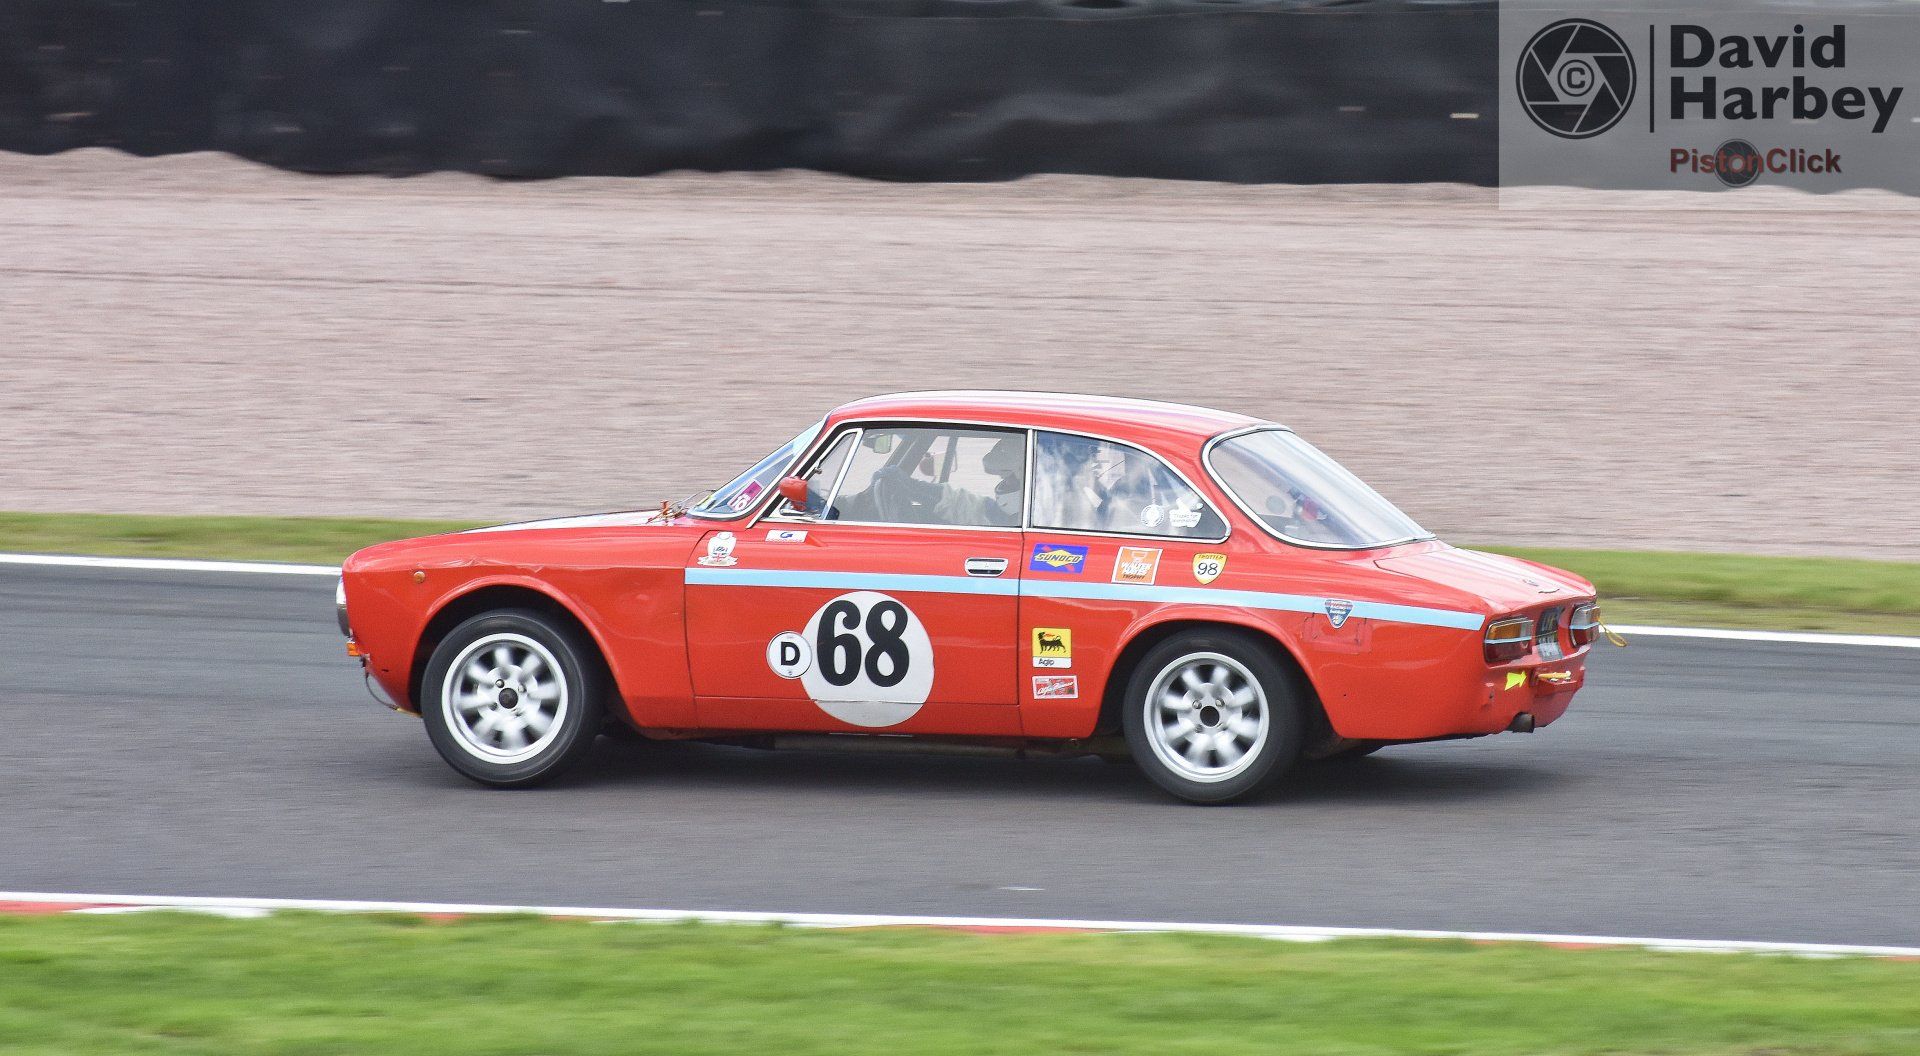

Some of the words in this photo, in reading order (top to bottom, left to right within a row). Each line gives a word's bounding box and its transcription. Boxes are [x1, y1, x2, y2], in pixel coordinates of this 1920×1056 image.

[1037, 553, 1081, 563] SUNOCO
[1197, 562, 1218, 576] 98
[780, 641, 801, 666] D
[816, 600, 910, 688] 68
